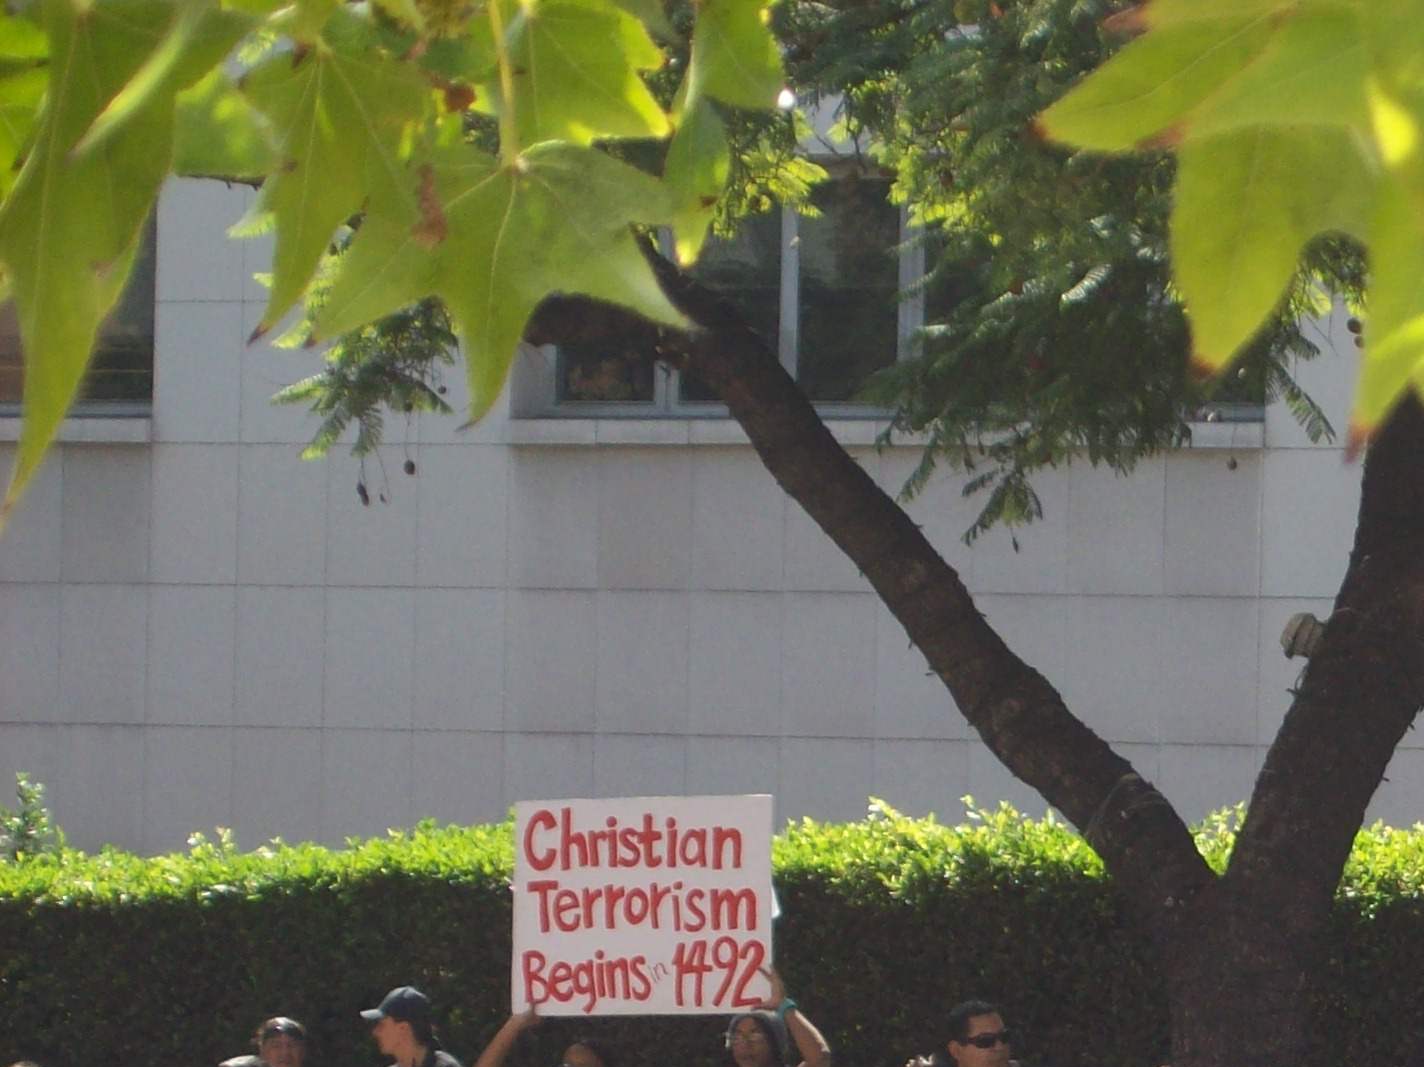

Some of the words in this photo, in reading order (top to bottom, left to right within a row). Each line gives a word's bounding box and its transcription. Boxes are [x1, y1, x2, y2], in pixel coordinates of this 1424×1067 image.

[524, 807, 742, 871] Christian
[527, 880, 757, 933] Terrorism
[523, 949, 651, 1013] Begins
[650, 961, 669, 984] in
[672, 936, 765, 1007] 1492
